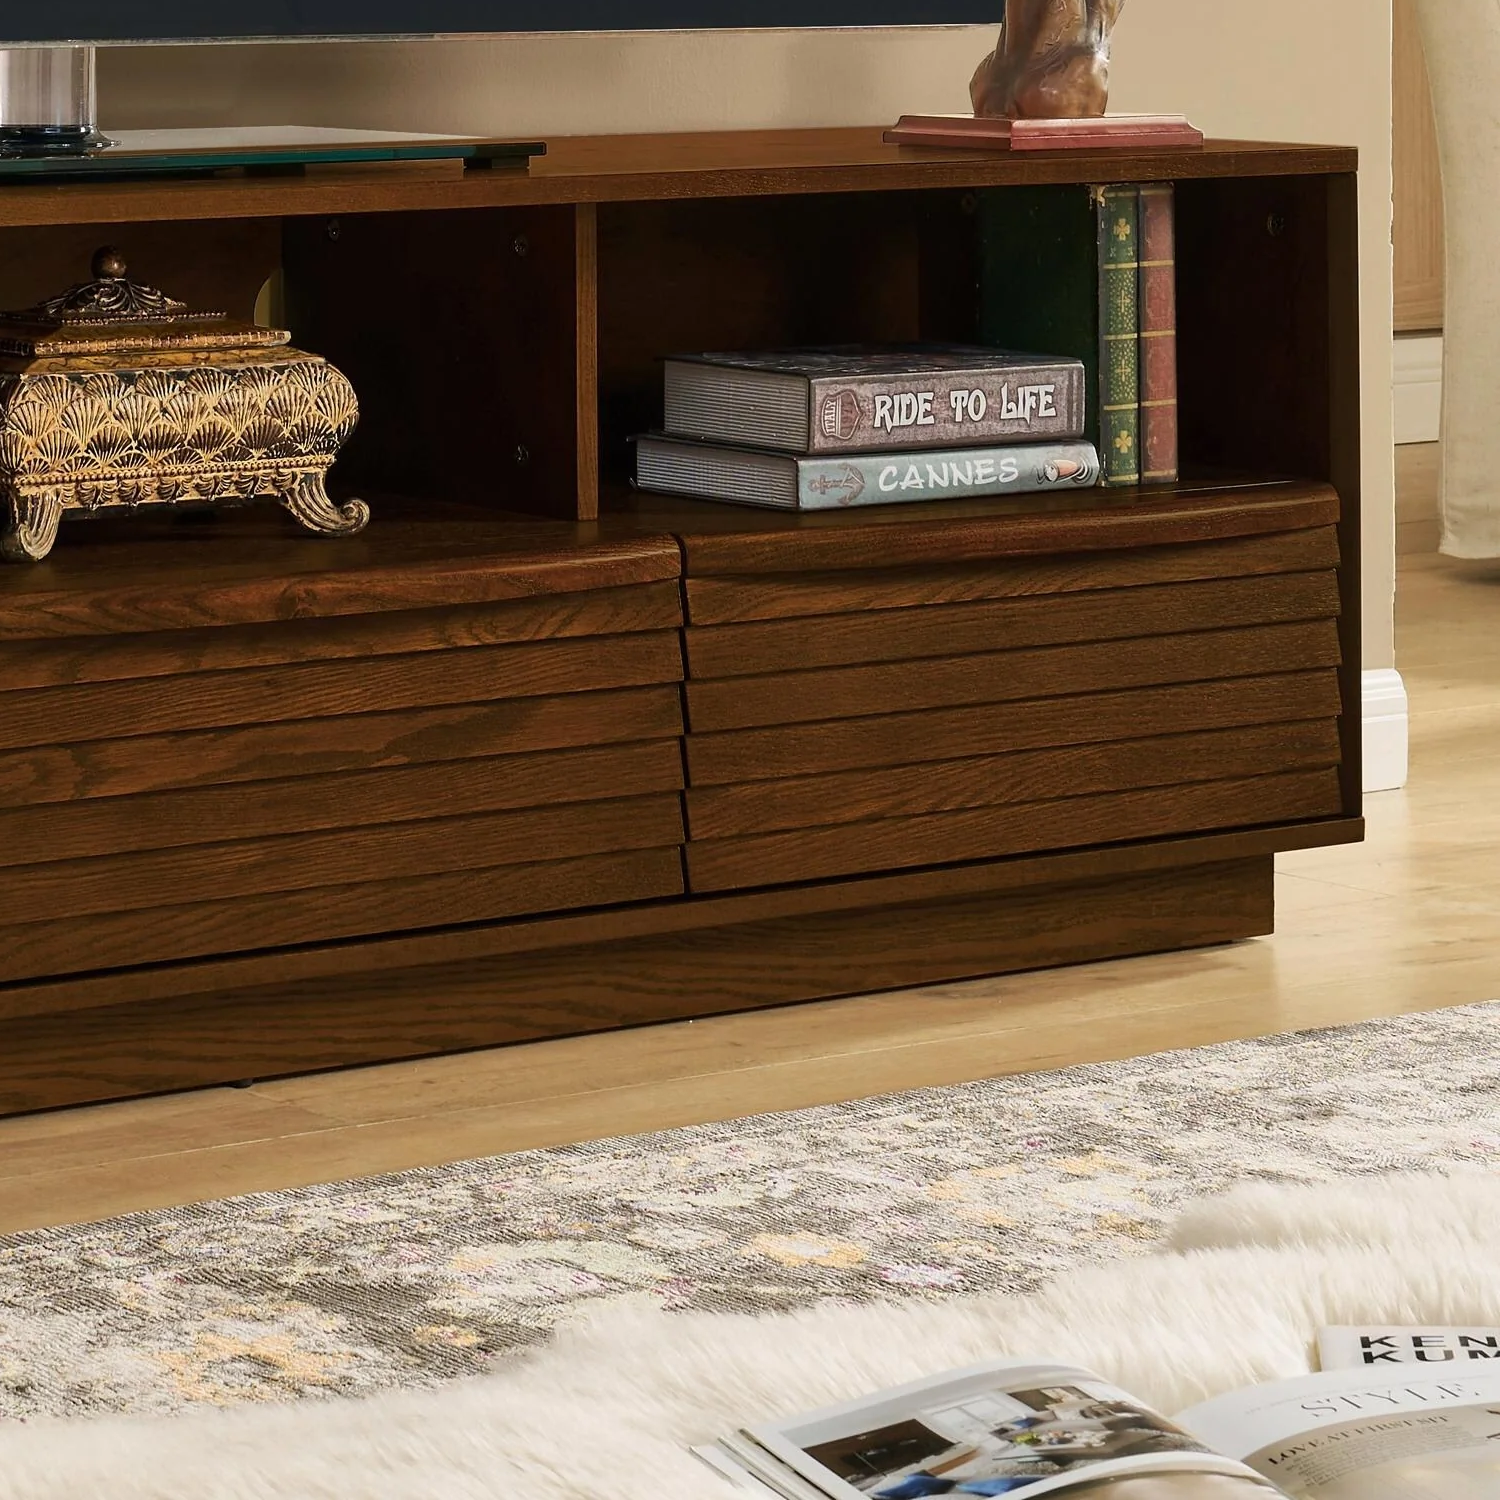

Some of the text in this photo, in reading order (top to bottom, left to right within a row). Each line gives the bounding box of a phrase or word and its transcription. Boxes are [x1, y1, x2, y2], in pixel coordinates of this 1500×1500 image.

[824, 400, 836, 433] ITALY
[873, 391, 935, 434] RIDE
[950, 388, 987, 422] TO
[1000, 384, 1057, 423] LIFE
[878, 456, 1019, 492] CANNES
[1268, 1436, 1325, 1466] LOVE
